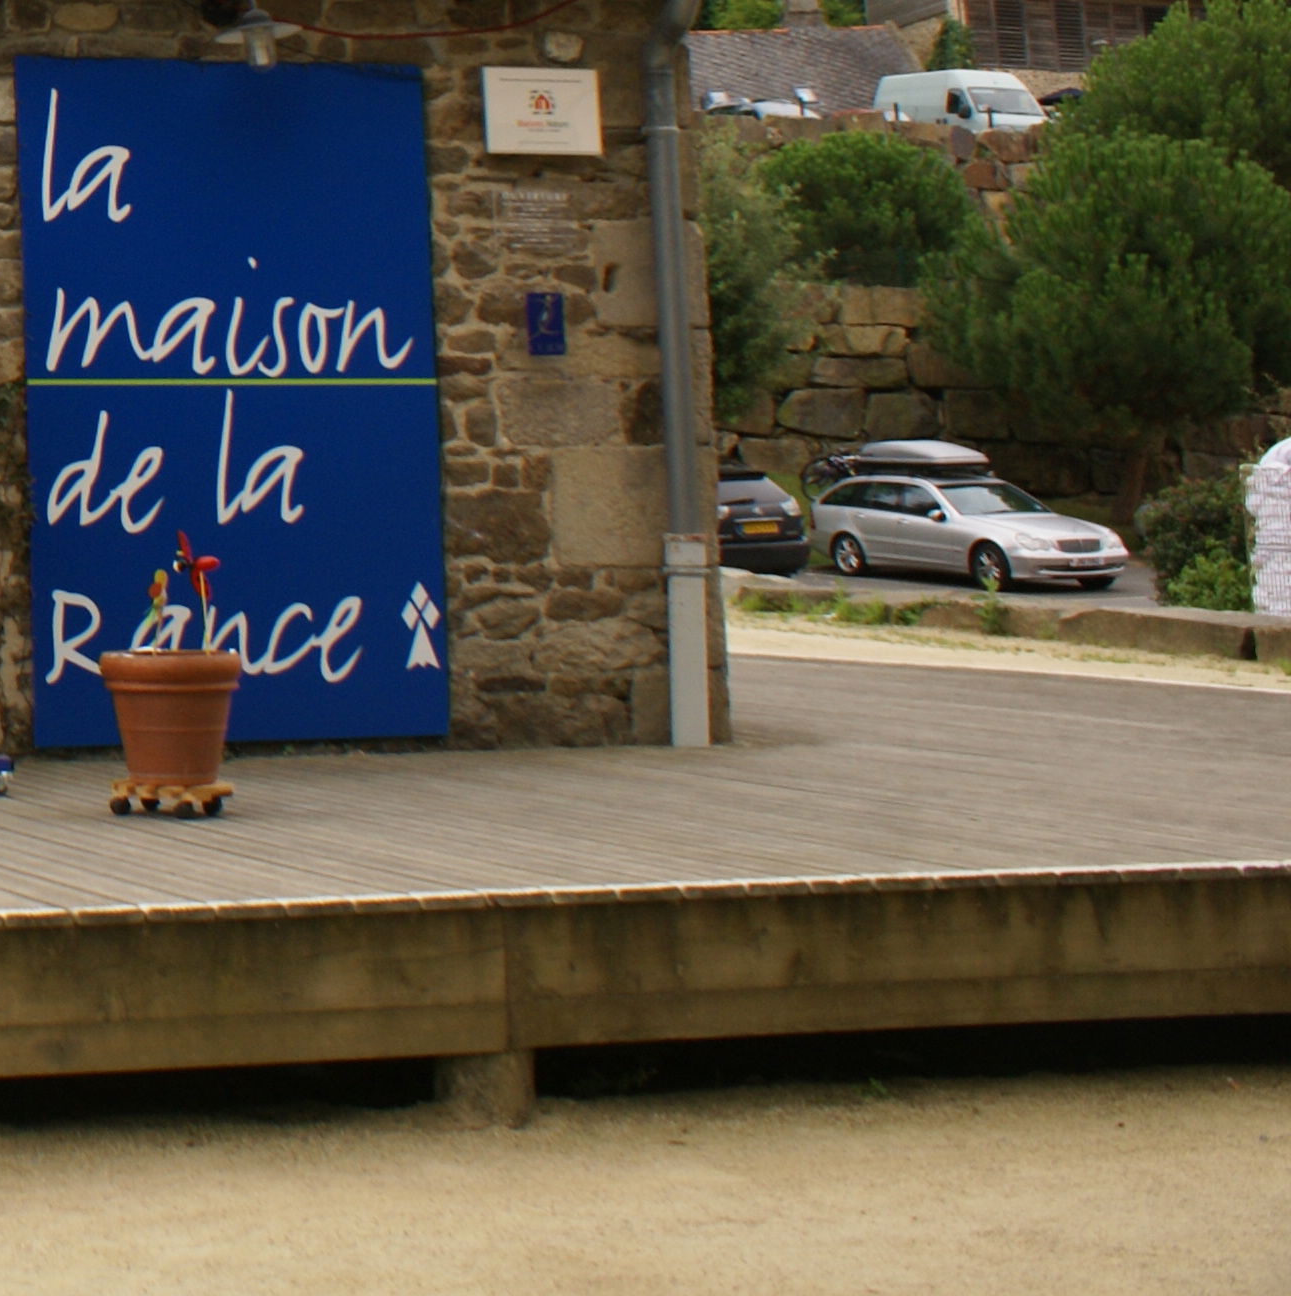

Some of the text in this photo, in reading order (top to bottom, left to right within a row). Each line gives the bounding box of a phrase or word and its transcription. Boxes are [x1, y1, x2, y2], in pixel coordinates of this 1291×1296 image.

[42, 88, 131, 222] la
[46, 256, 413, 378] maison
[47, 388, 305, 534] de la
[46, 590, 363, 682] Rance
